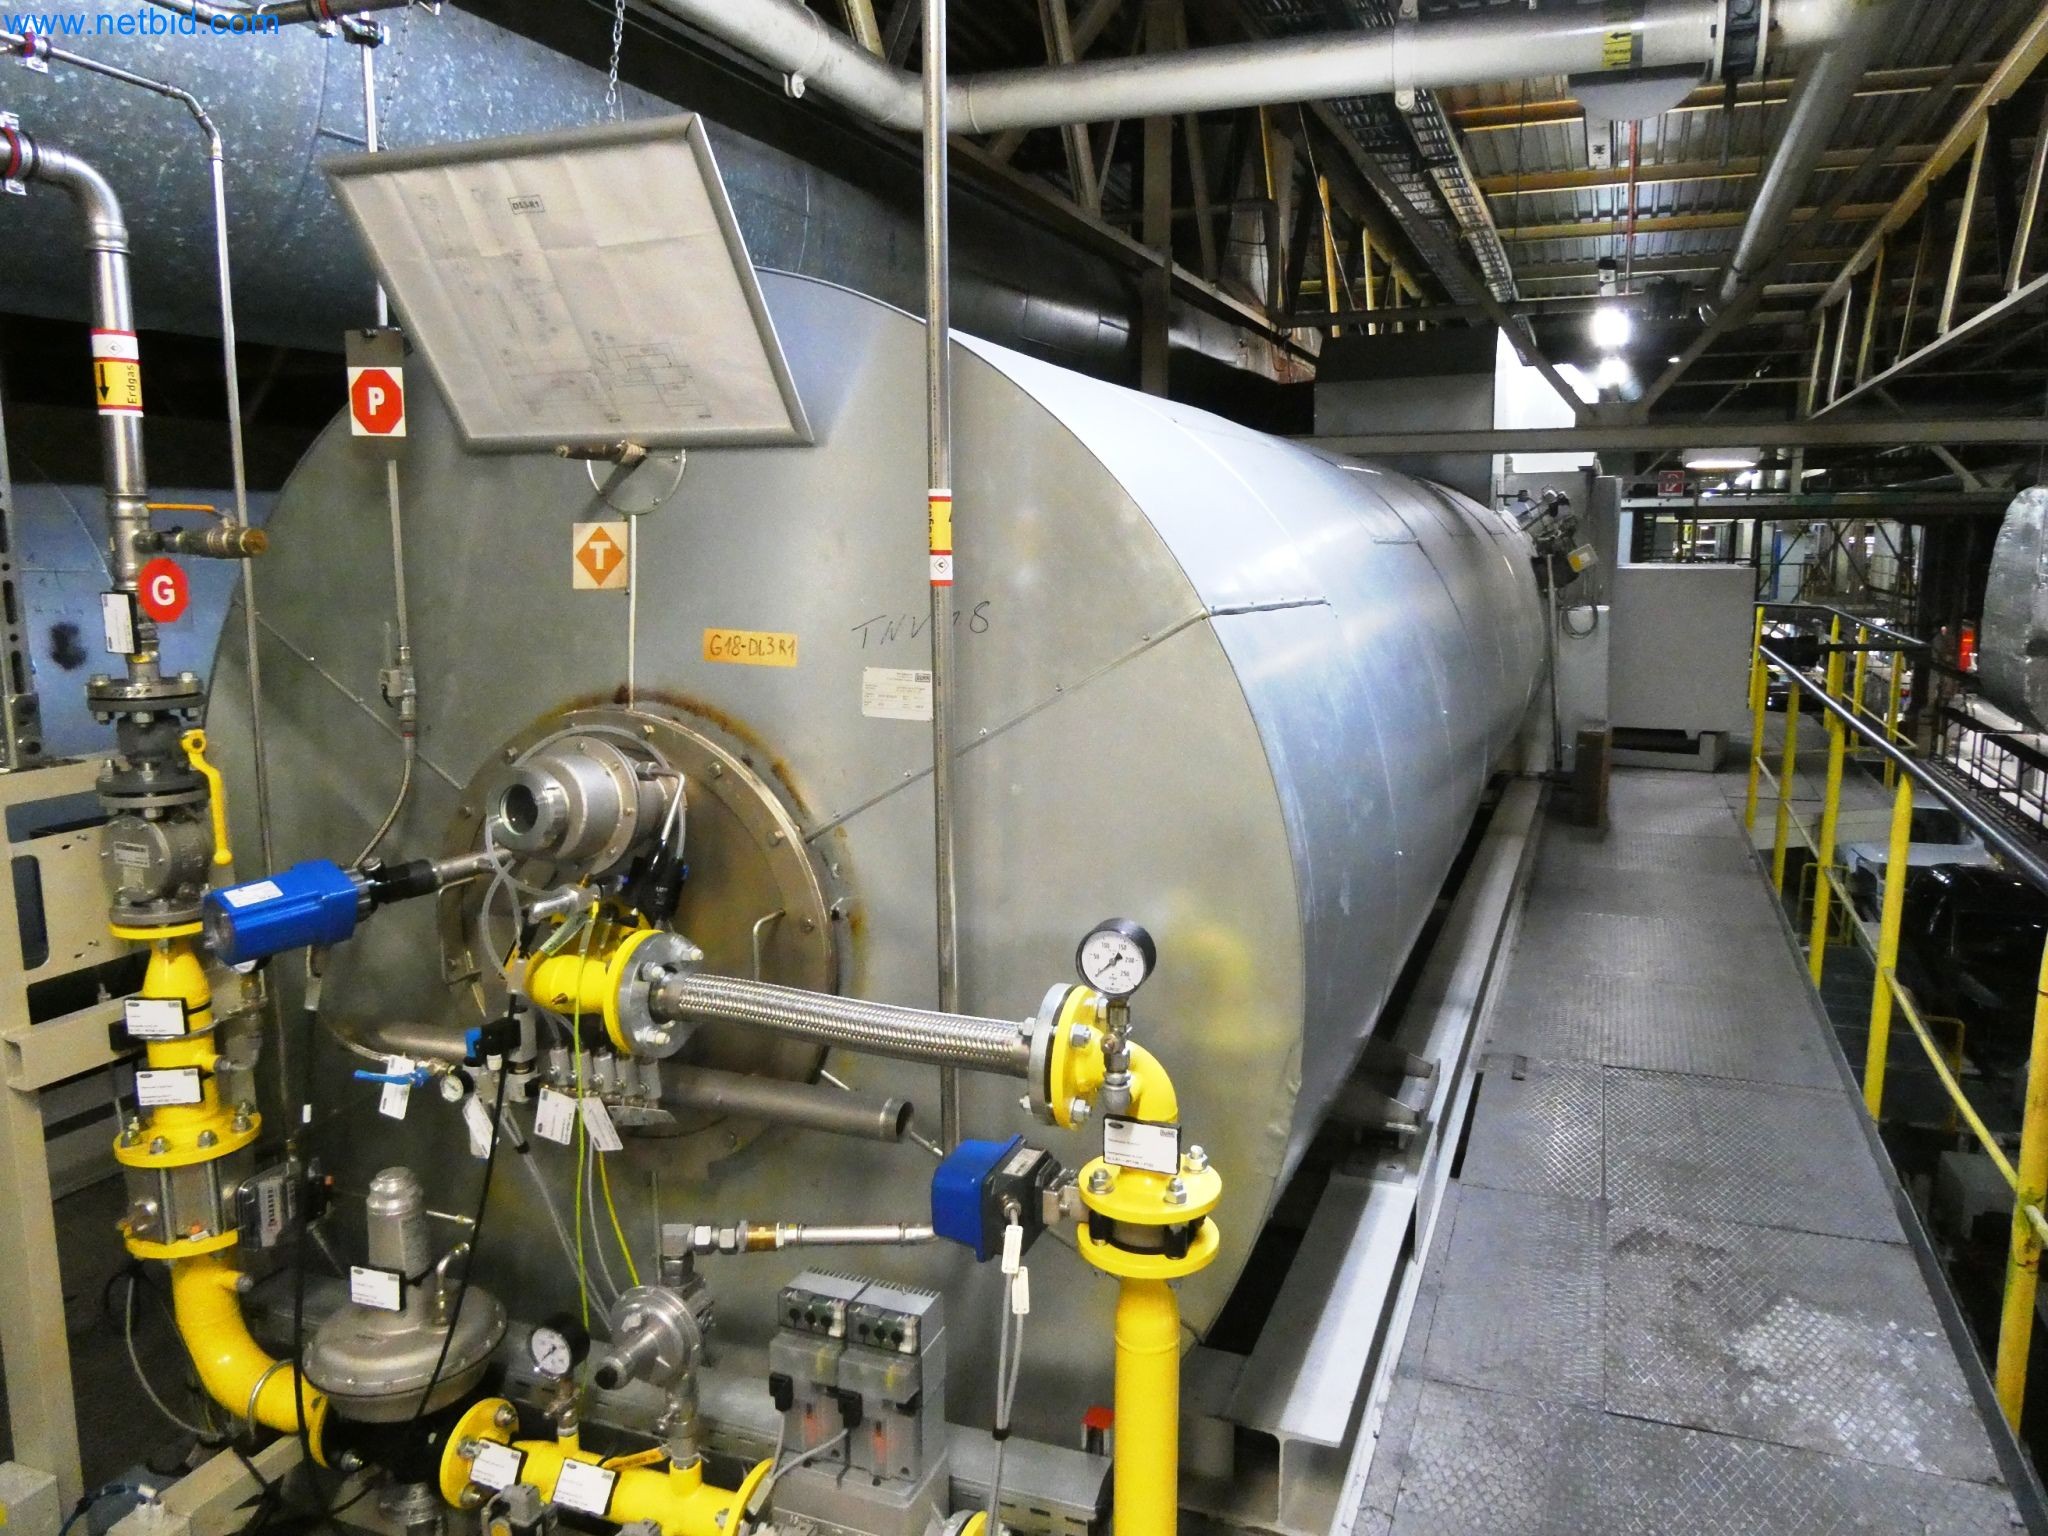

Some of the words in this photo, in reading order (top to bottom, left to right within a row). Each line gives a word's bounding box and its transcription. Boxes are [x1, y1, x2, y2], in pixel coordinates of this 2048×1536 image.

[126, 364, 138, 404] Erdgas
[367, 386, 386, 416] P
[588, 540, 612, 570] T
[151, 574, 176, 606] G
